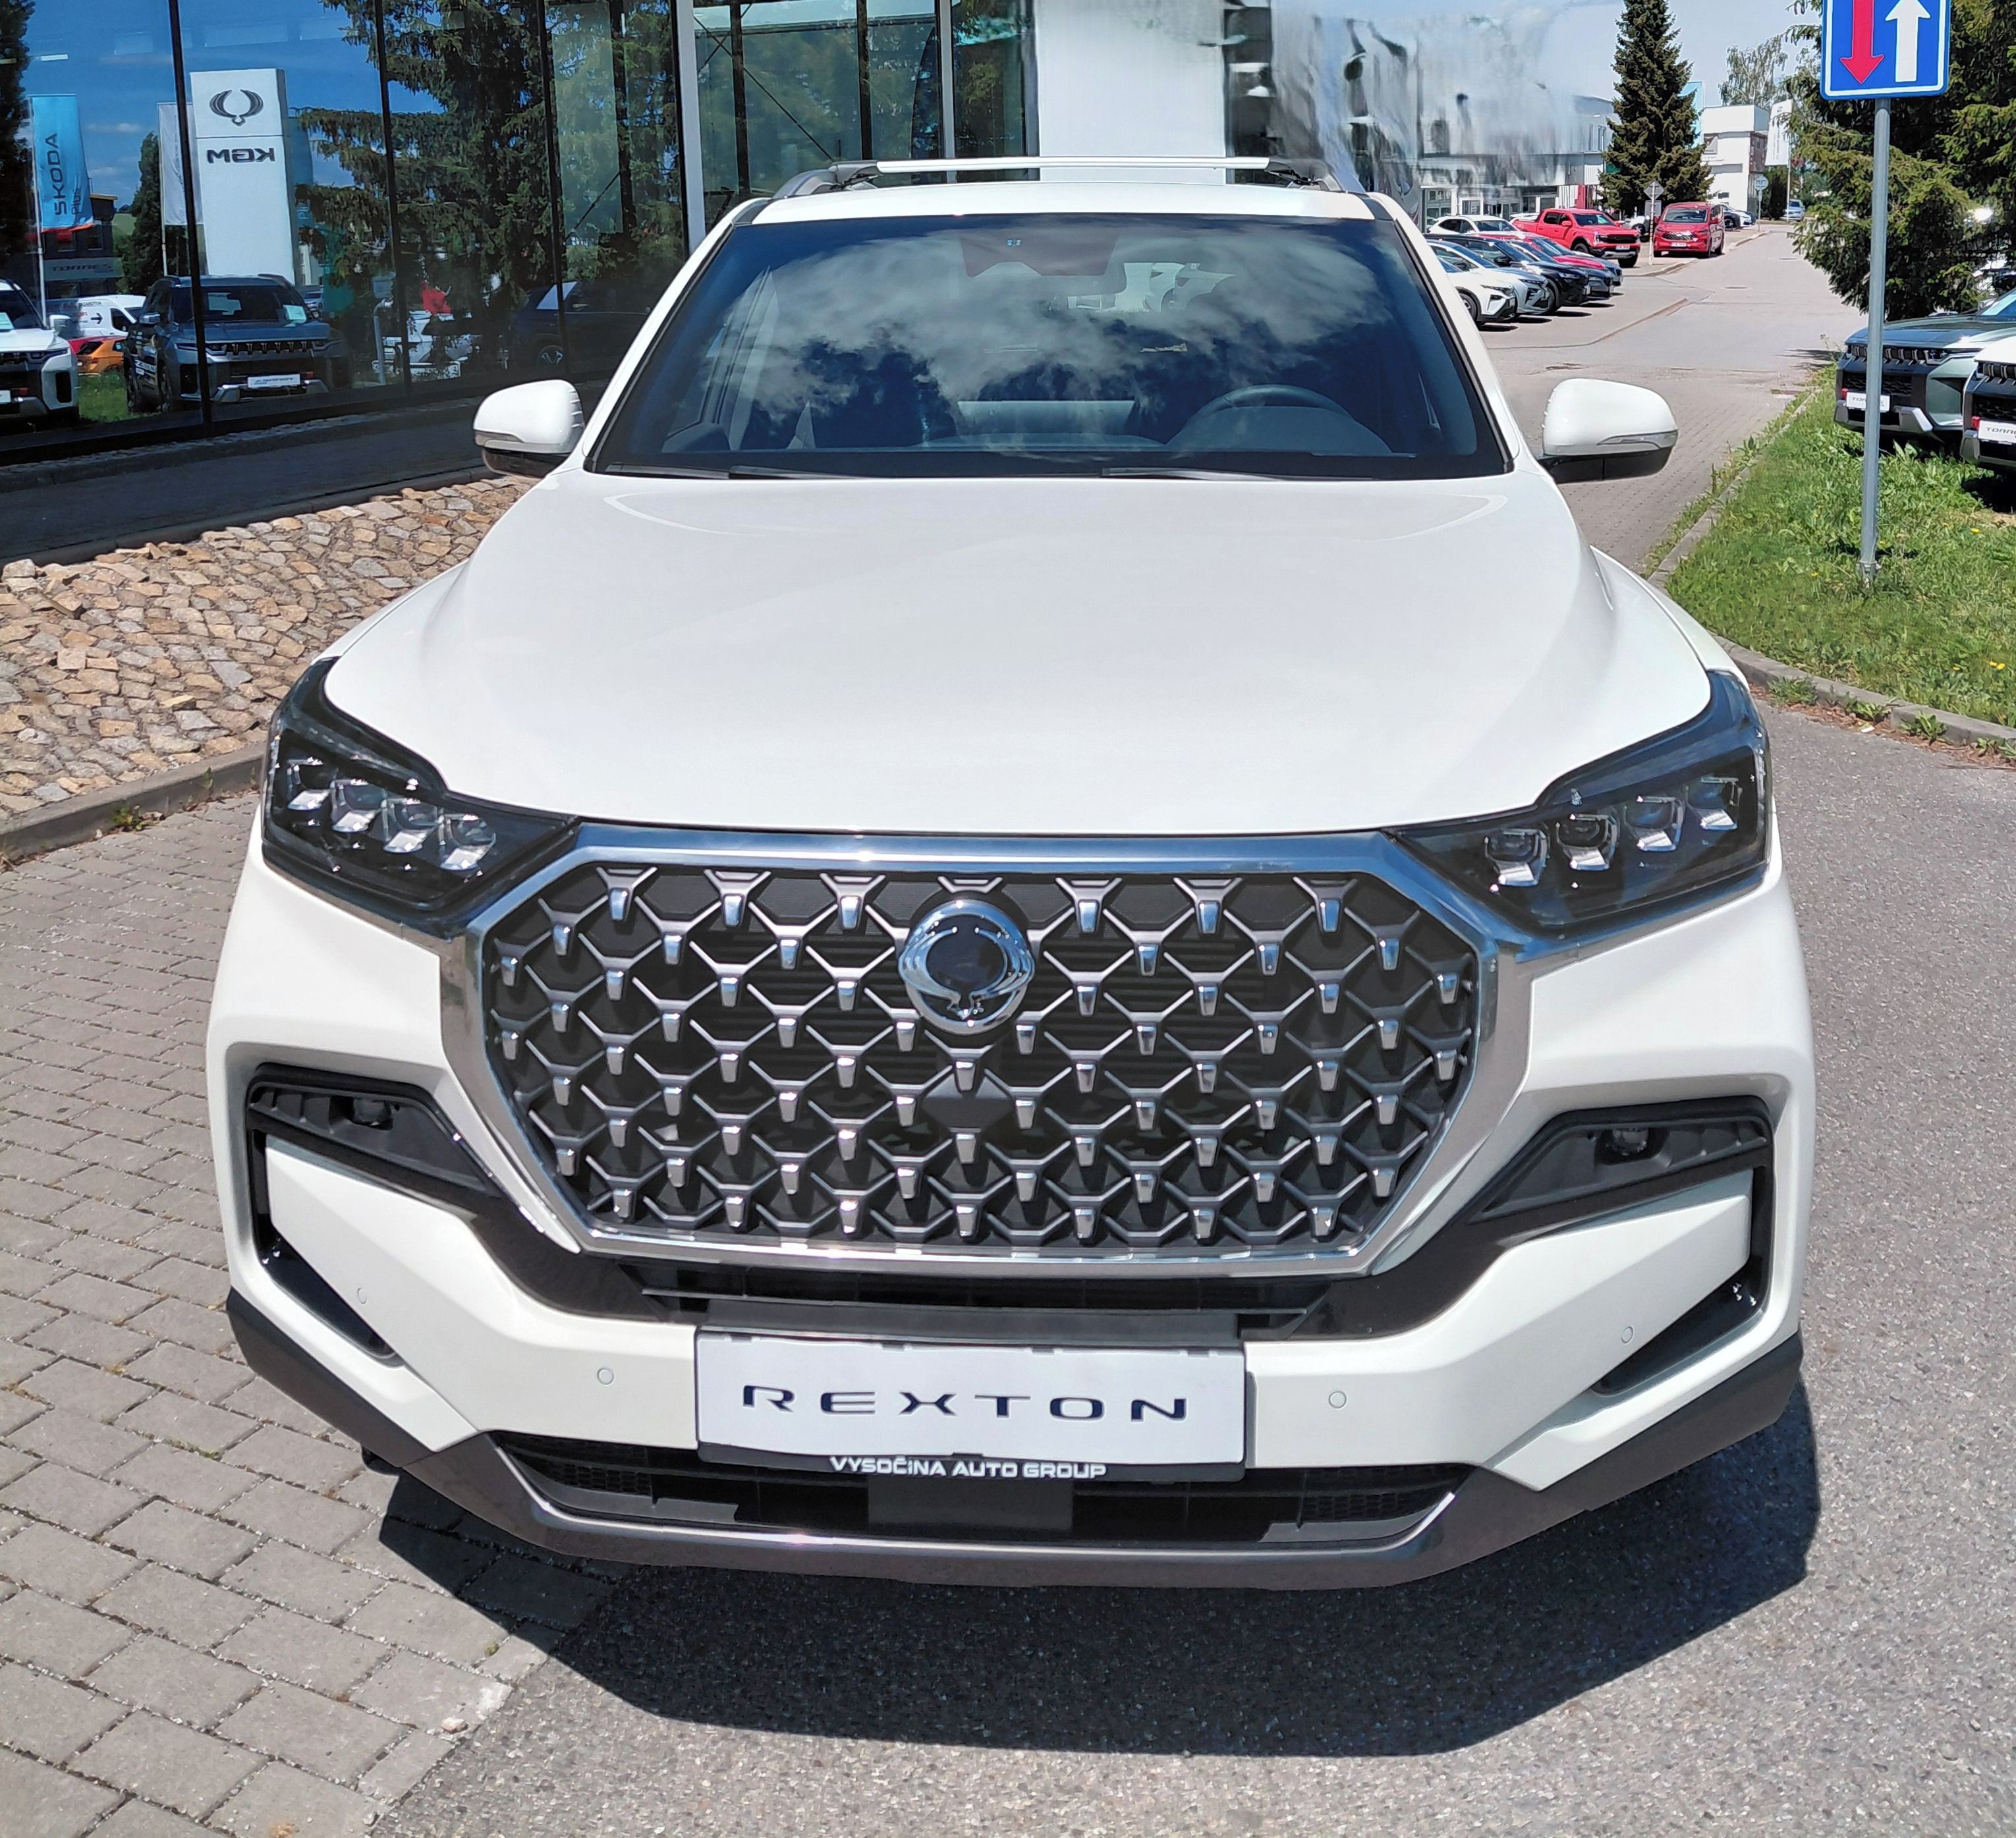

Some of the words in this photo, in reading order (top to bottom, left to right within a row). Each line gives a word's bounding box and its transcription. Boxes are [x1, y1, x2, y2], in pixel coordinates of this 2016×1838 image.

[743, 1385, 1187, 1422] REXTON
[829, 1455, 947, 1476] VYSOČINA
[952, 1461, 1018, 1478] AUTO
[1023, 1462, 1107, 1479] GROUP
